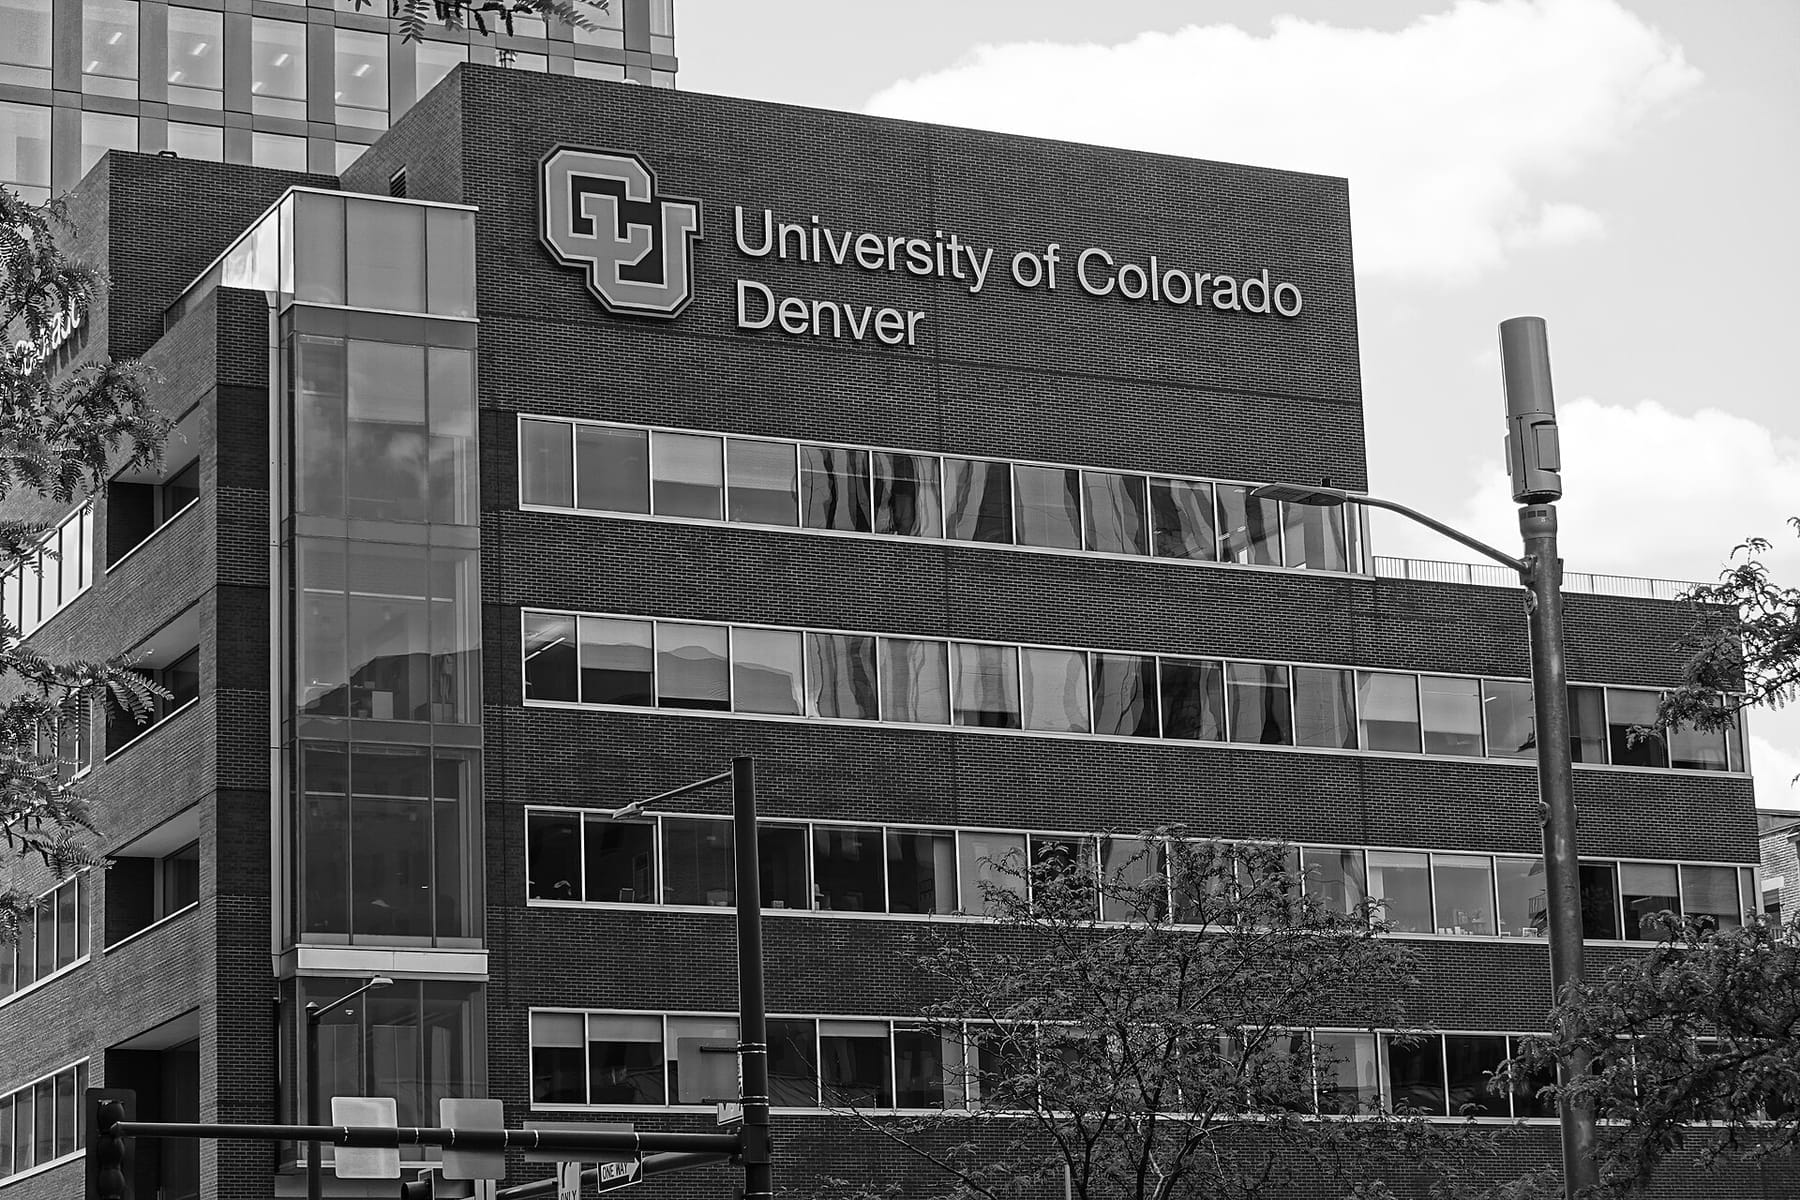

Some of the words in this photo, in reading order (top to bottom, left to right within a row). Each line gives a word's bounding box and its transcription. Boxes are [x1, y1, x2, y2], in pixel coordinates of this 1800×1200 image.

[734, 204, 995, 294] University
[1011, 243, 1061, 290] of
[1076, 247, 1304, 318] Colorado
[736, 278, 926, 347] Denver
[602, 1164, 615, 1179] ONE
[615, 1162, 627, 1176] WAY
